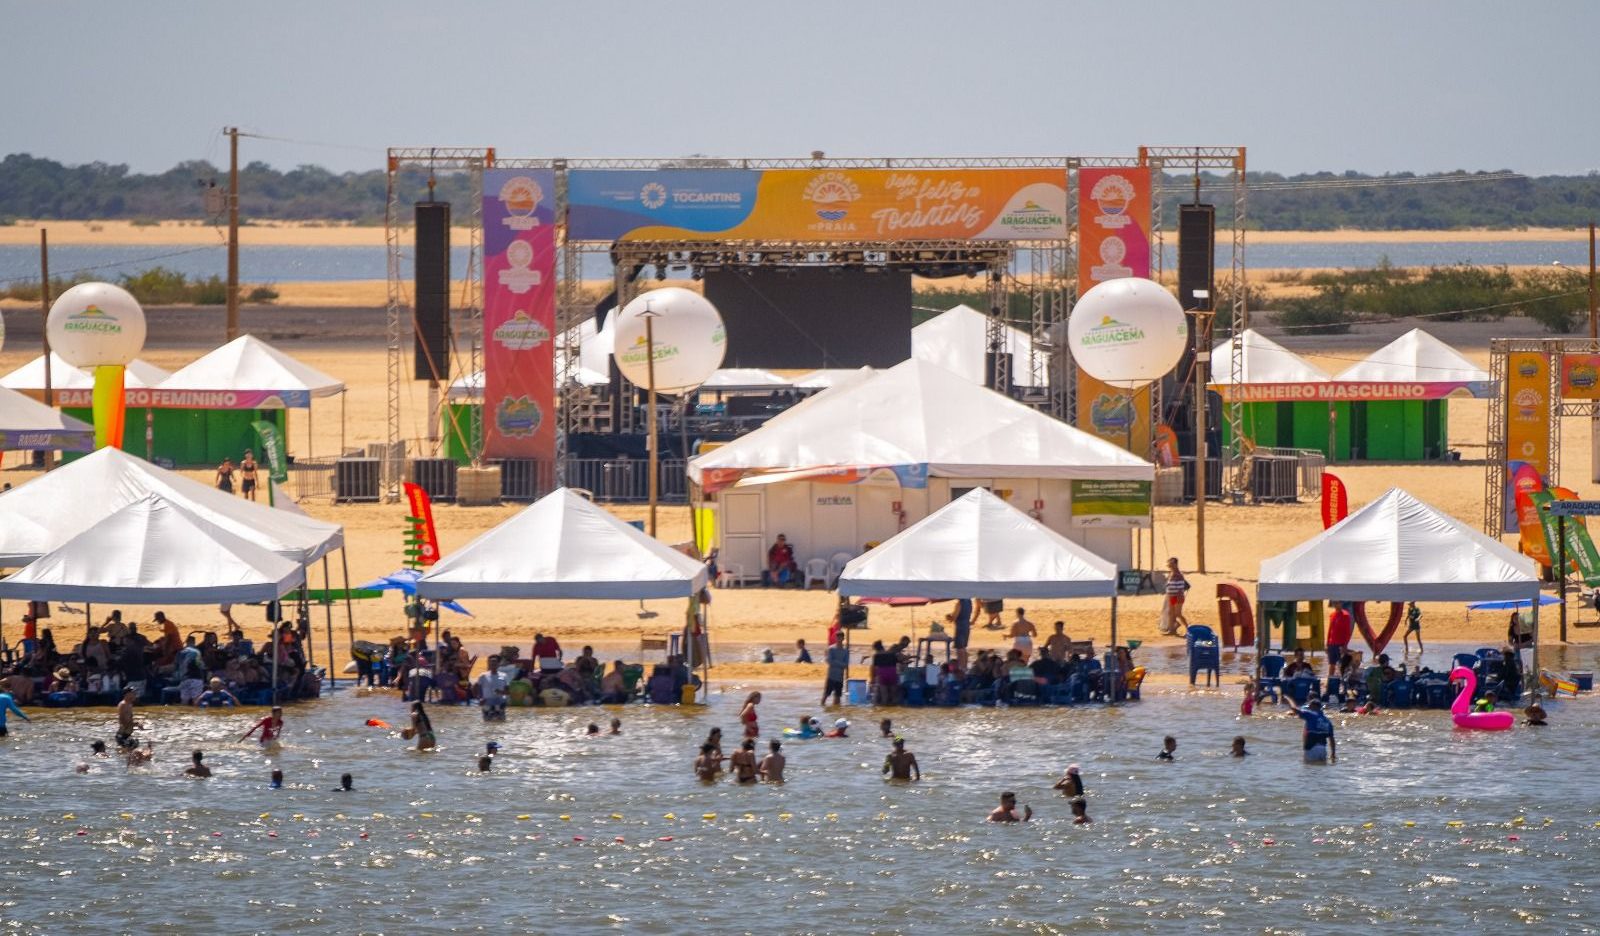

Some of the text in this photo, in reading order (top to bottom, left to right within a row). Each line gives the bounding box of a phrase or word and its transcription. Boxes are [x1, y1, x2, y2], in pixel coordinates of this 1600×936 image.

[672, 191, 741, 203] TOCANTINS
[817, 221, 857, 232] PRAIA
[872, 202, 985, 236] Tocantins
[1000, 215, 1063, 226] ARAGUACEMA
[59, 391, 237, 406] BANRO FEMININO
[1225, 384, 1425, 400] BANHEIRO MASCULINO
[1330, 480, 1339, 526] MBEIROS
